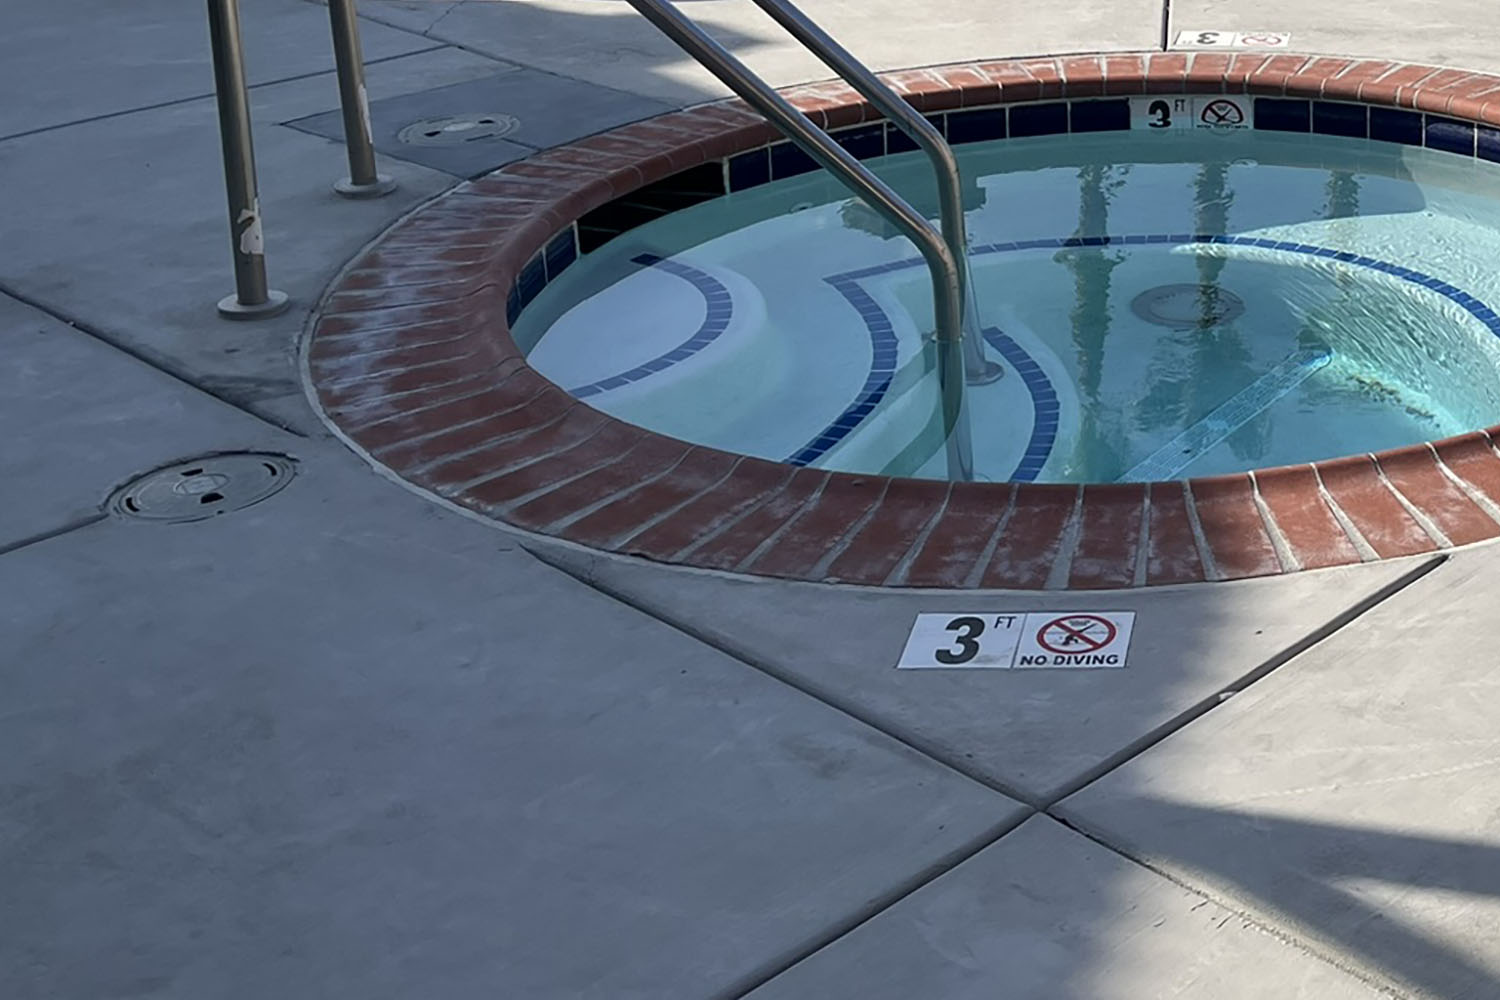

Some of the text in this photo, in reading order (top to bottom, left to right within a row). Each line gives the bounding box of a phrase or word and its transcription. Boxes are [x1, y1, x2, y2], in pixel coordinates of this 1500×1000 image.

[1196, 32, 1220, 45] 3
[1148, 100, 1172, 128] 3
[934, 616, 1017, 665] 3 FT
[1019, 654, 1119, 666] NO DIVING
